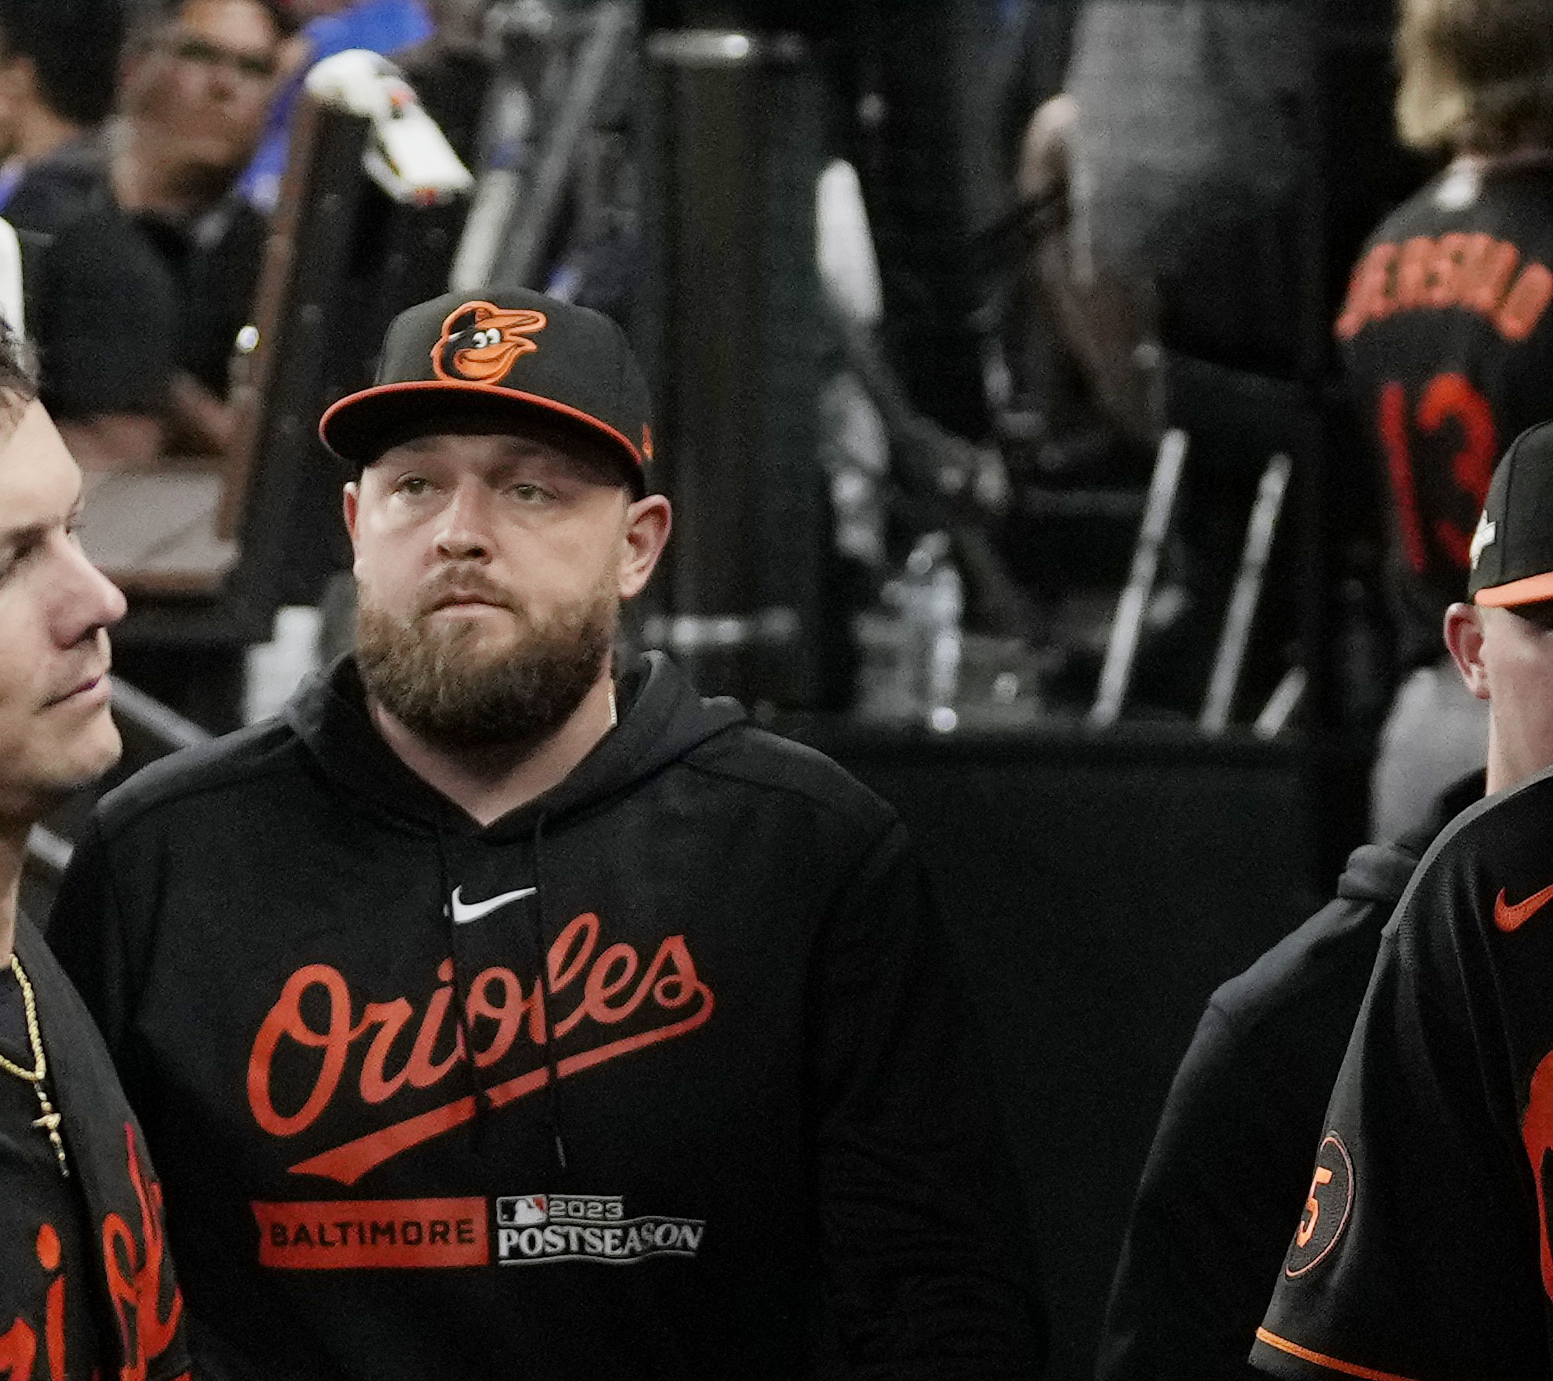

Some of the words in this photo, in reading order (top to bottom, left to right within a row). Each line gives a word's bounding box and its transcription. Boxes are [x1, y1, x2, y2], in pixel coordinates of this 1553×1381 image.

[246, 911, 715, 1137] Orioles
[548, 1200, 623, 1220] 2023
[270, 1217, 476, 1248] BALTIMORE
[497, 1222, 705, 1259] POSTSEASON
